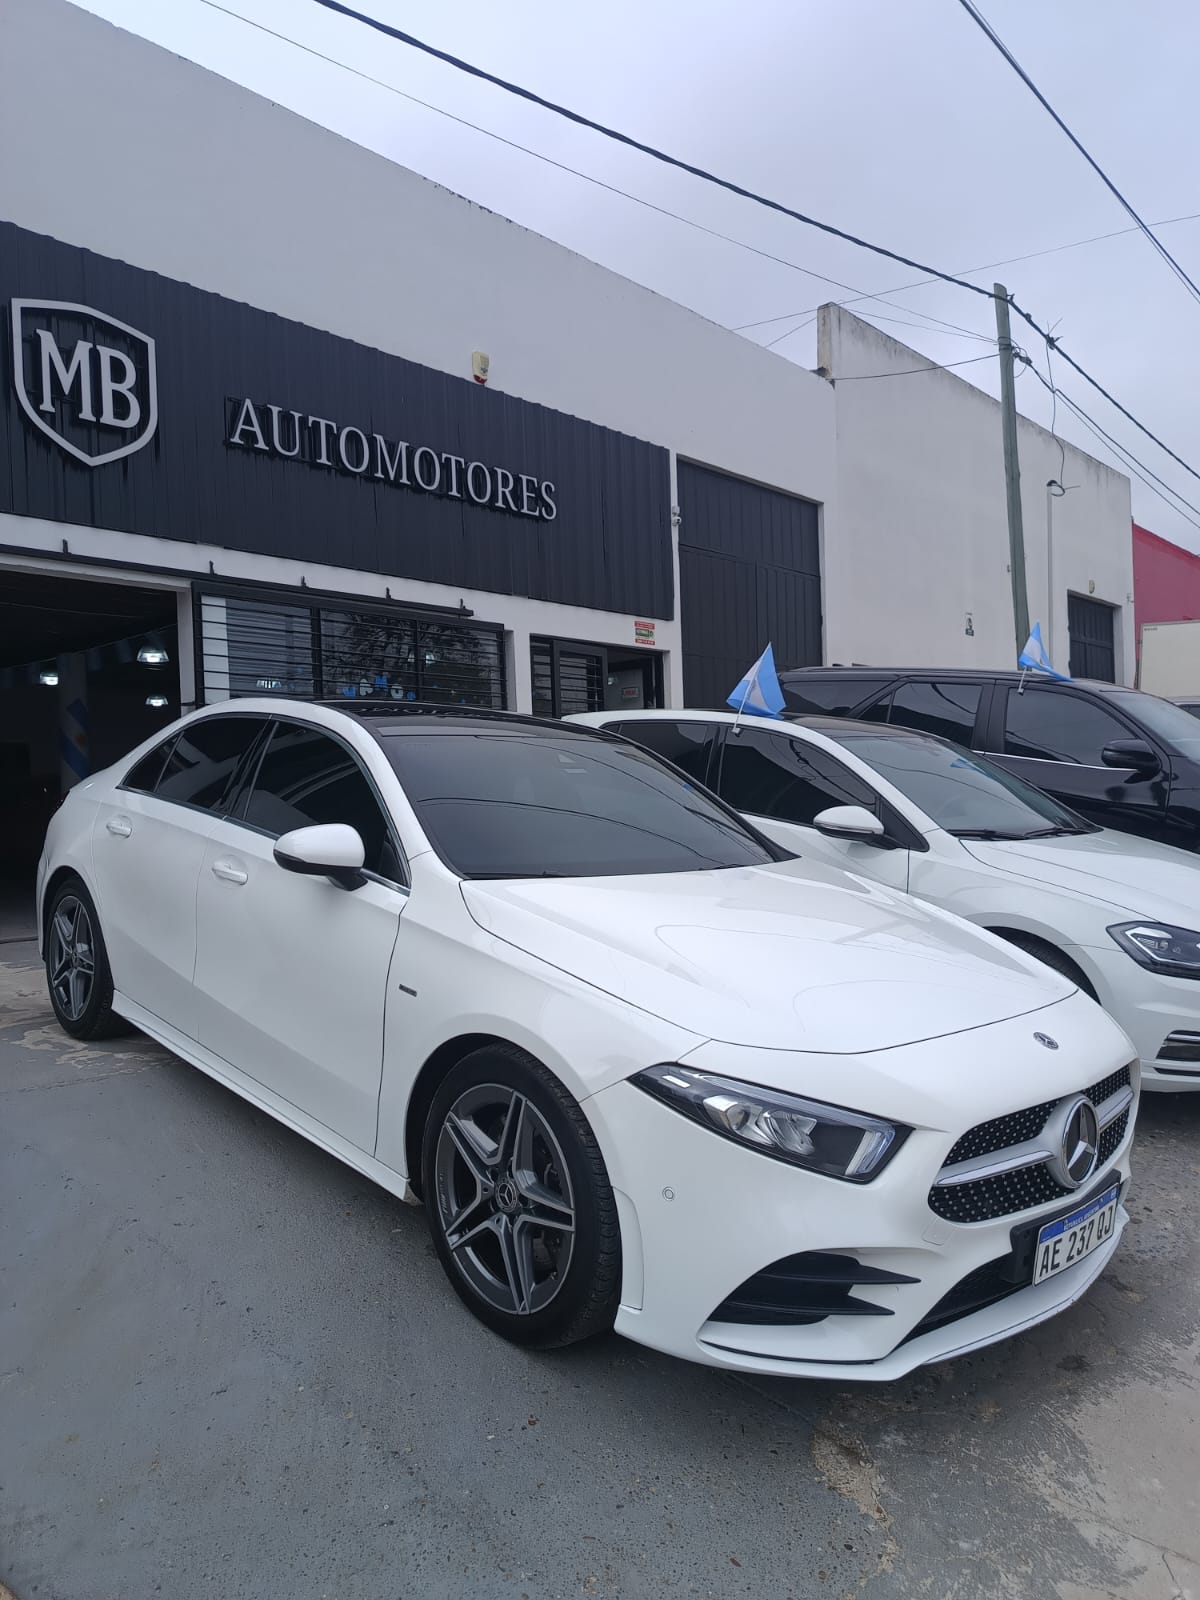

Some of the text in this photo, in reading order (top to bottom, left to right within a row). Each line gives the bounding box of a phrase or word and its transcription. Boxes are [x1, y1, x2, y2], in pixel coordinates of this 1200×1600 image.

[36, 328, 140, 428] MB
[229, 398, 558, 521] AUTOMOTORES
[1039, 1238, 1063, 1277] AE
[1066, 1219, 1095, 1263] 237
[1097, 1205, 1114, 1241] QJ
